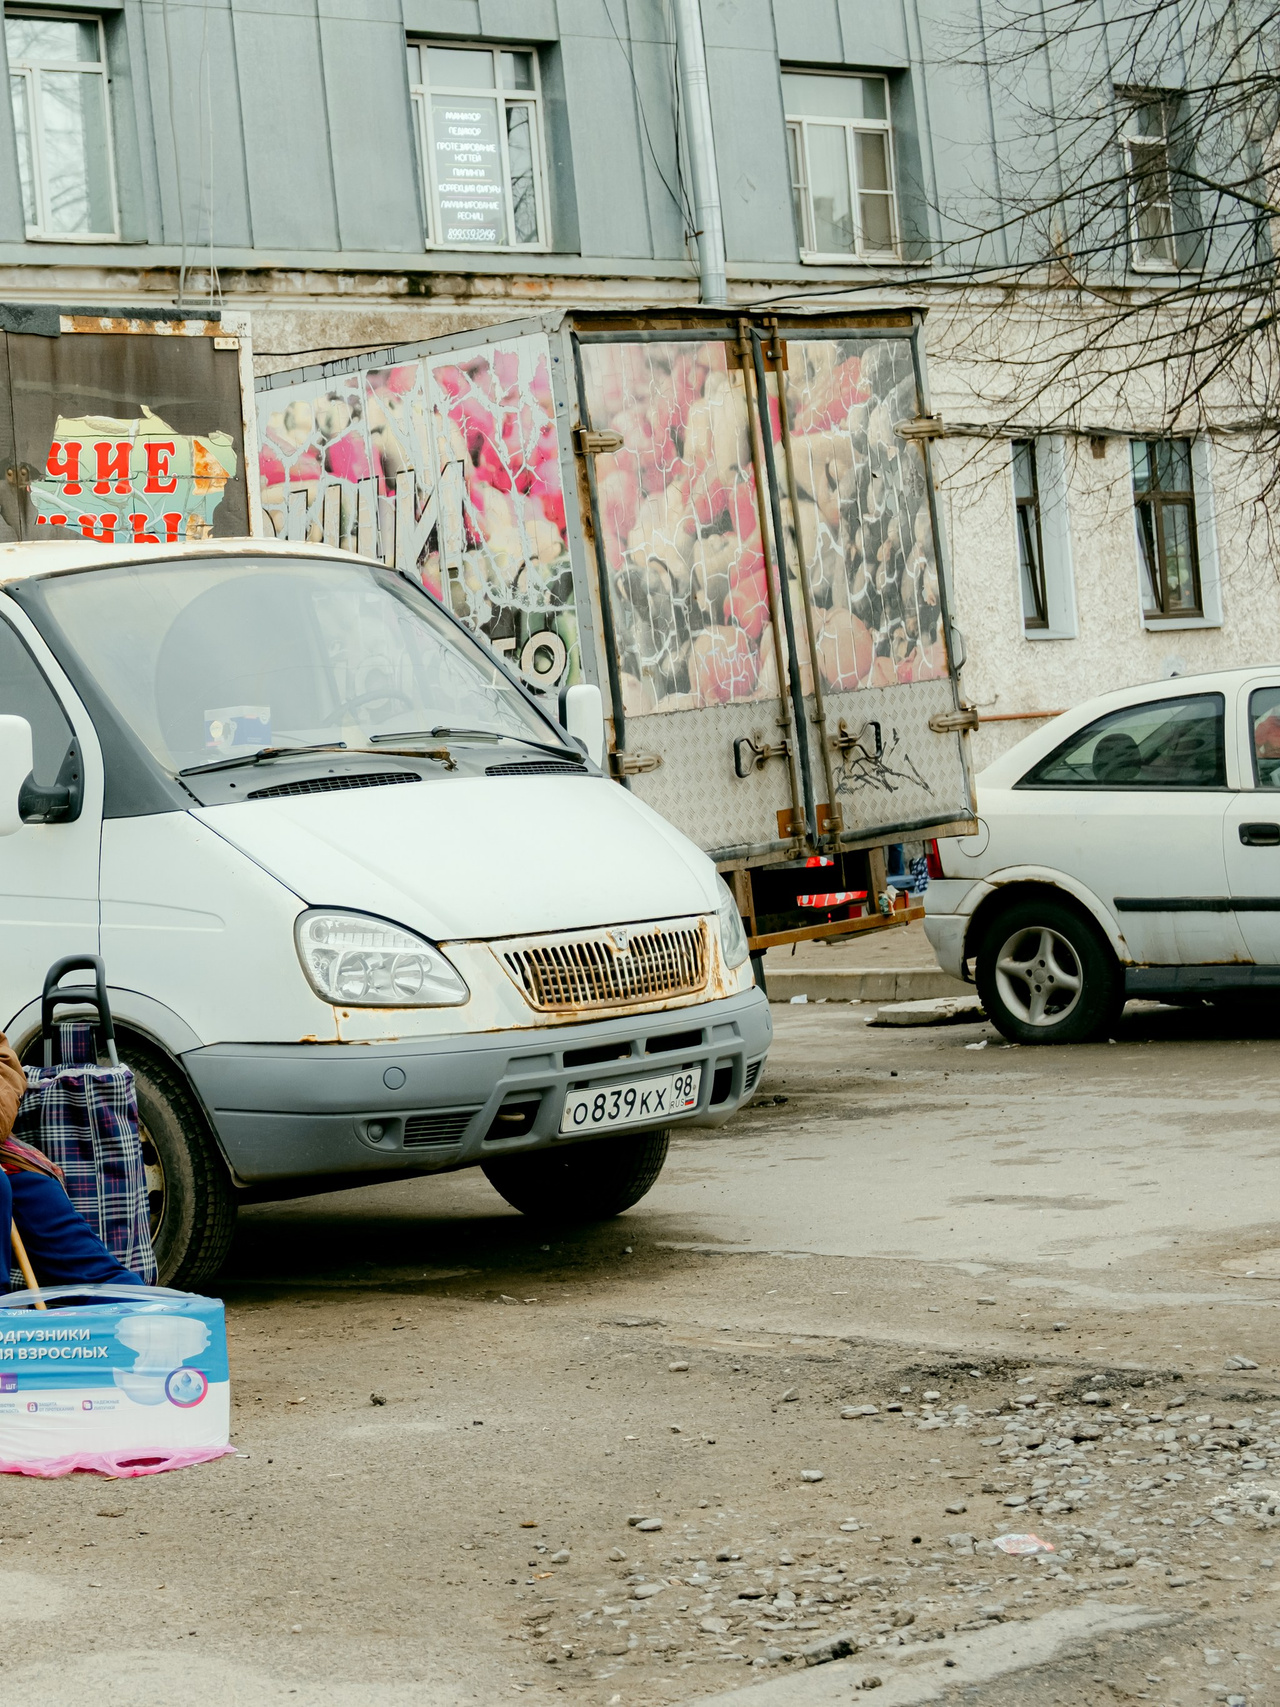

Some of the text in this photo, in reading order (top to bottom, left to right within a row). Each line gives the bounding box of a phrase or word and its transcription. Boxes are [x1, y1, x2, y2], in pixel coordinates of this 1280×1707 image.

[454, 152, 481, 162] НОГТЕЙ
[457, 212, 484, 221] РЕСНИЦ
[674, 1074, 693, 1100] 98
[670, 1098, 685, 1109] RUS
[18, 1346, 108, 1360] ВЗРОСЛЫХ
